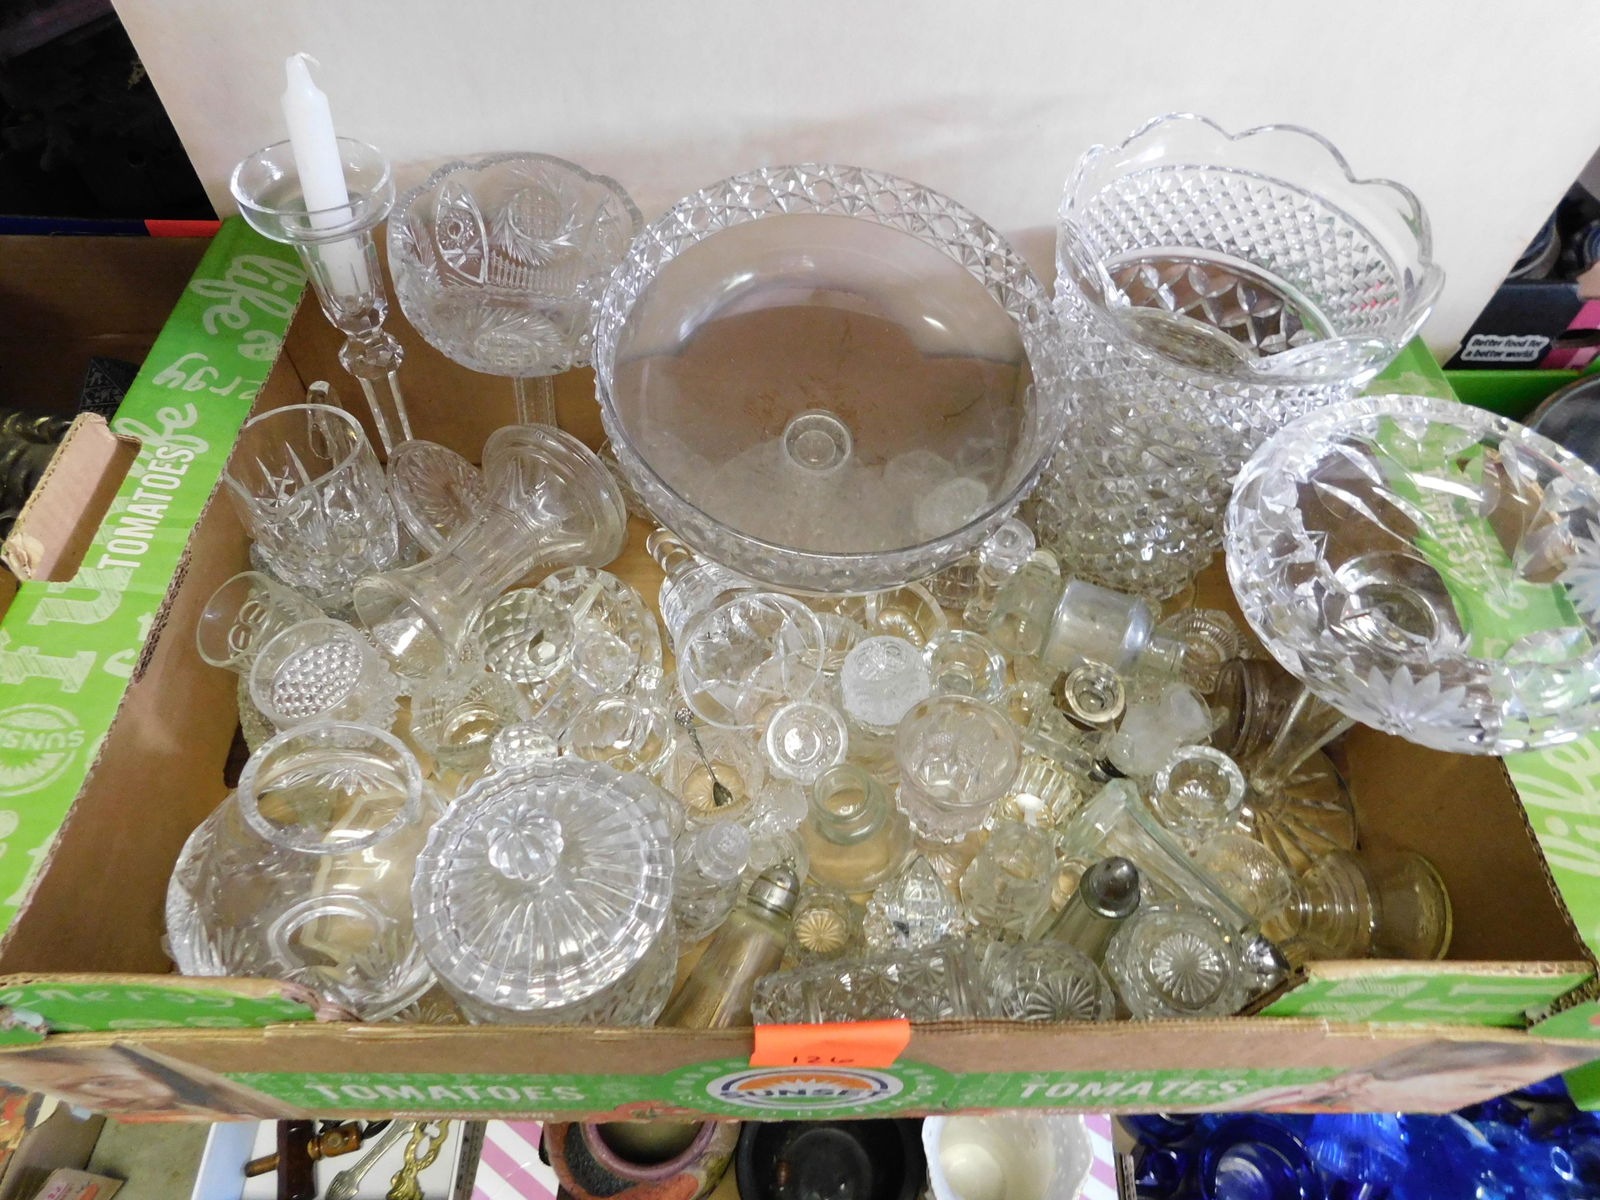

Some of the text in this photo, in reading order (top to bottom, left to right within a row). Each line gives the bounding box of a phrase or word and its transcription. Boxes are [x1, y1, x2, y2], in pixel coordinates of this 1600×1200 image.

[1504, 339, 1527, 347] food
[97, 446, 195, 569] TOMATOES
[0, 729, 85, 751] SUNS
[303, 1083, 586, 1101] TOMATOES
[719, 1087, 892, 1100] SUNSET
[1019, 1079, 1248, 1099] TOMATES
